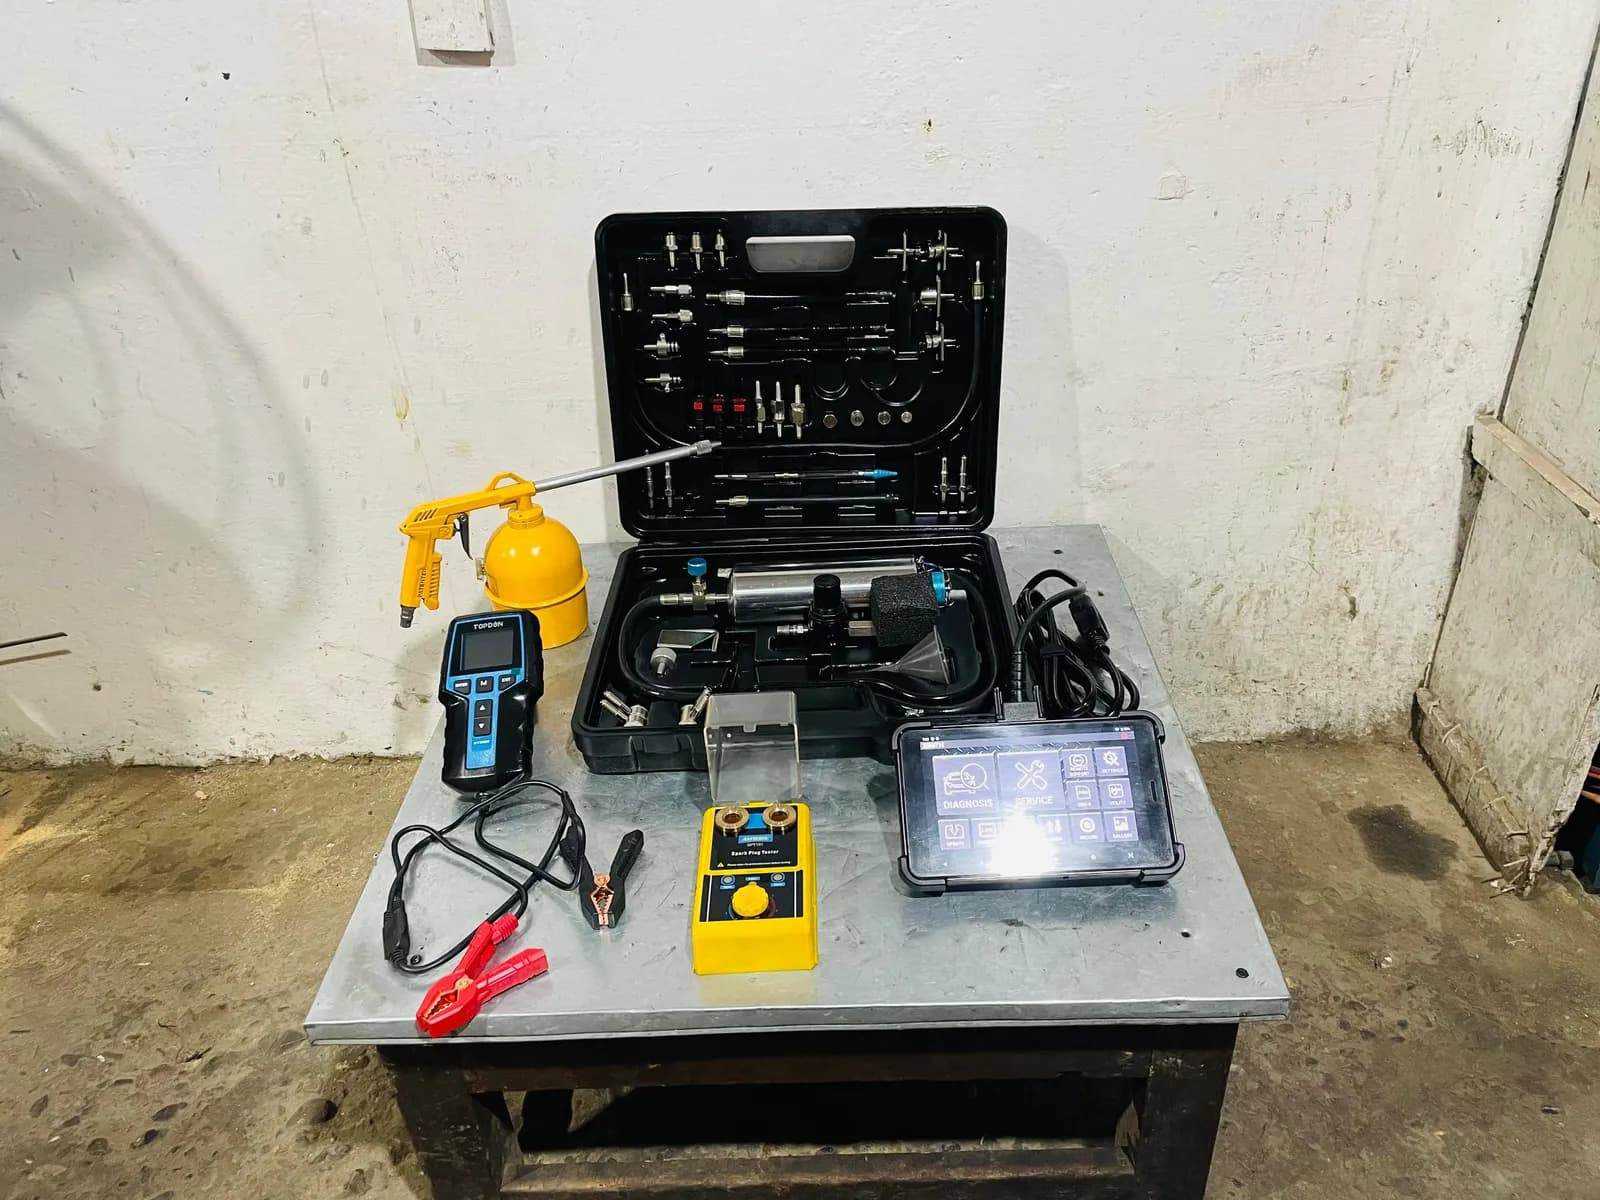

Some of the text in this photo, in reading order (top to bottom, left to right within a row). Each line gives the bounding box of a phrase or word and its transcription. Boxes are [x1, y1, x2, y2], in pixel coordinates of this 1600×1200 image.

[473, 621, 503, 630] TOPDON
[943, 799, 993, 809] DIAGNOSIS
[1015, 796, 1053, 807] SERVICE
